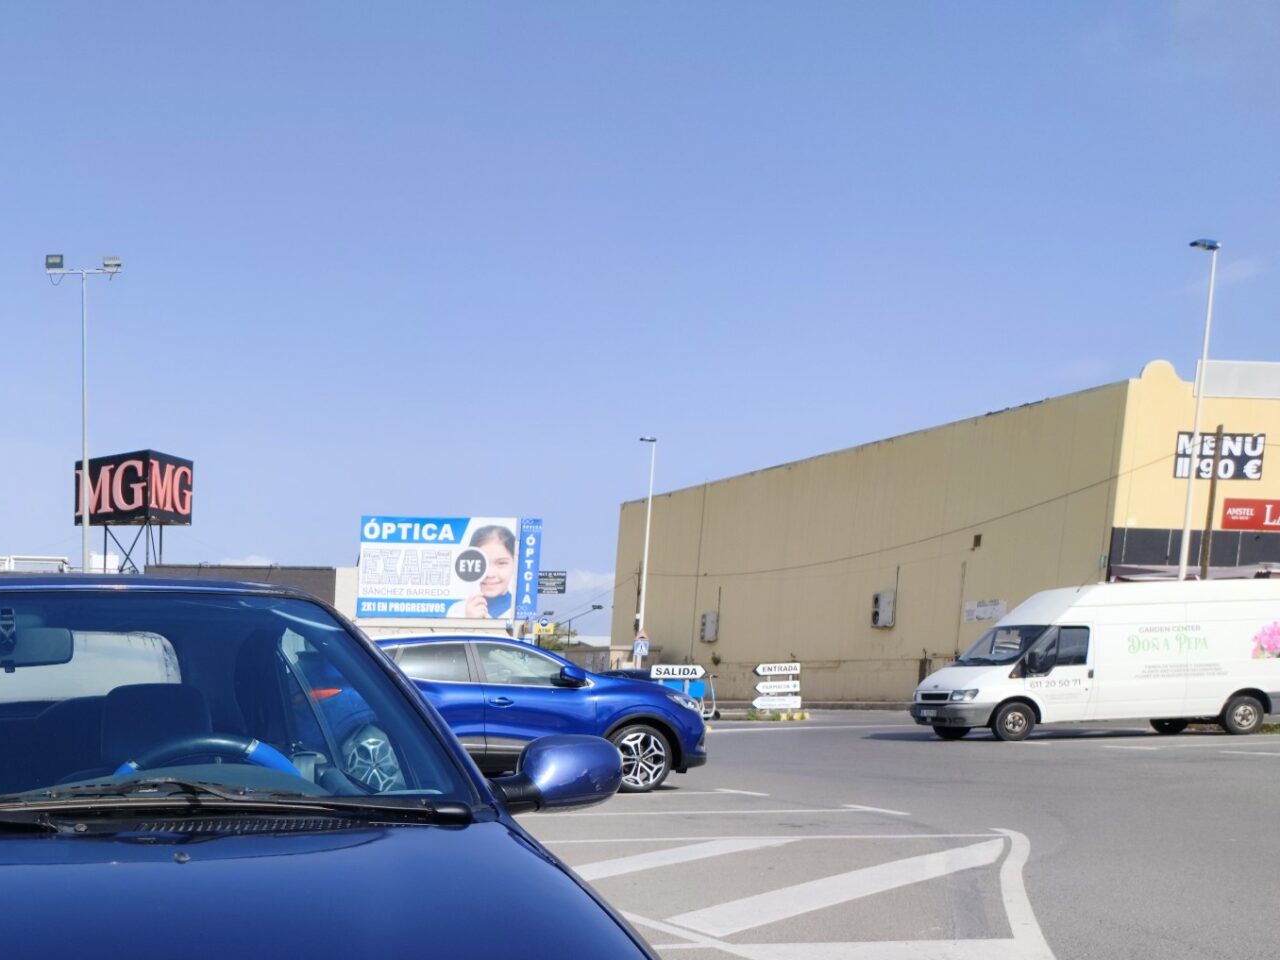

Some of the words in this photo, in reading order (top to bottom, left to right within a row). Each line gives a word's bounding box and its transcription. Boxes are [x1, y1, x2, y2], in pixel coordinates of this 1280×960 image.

[1177, 433, 1265, 456] MENÚ
[1243, 459, 1261, 479] €
[75, 460, 147, 516] MG
[149, 459, 192, 516] MG
[1226, 507, 1254, 516] AMSTEL
[363, 519, 454, 541] ÓPTICA
[459, 560, 481, 572] EYE
[406, 588, 449, 597] BARREDO
[361, 602, 375, 612] 2X1
[377, 602, 387, 612] EN
[389, 602, 446, 613] PROGRESIVOS
[655, 667, 697, 676] SALIDA
[762, 665, 798, 673] ENTRADA
[1045, 680, 1057, 688] 20
[1059, 679, 1071, 688] 50
[1073, 679, 1082, 687] 71
